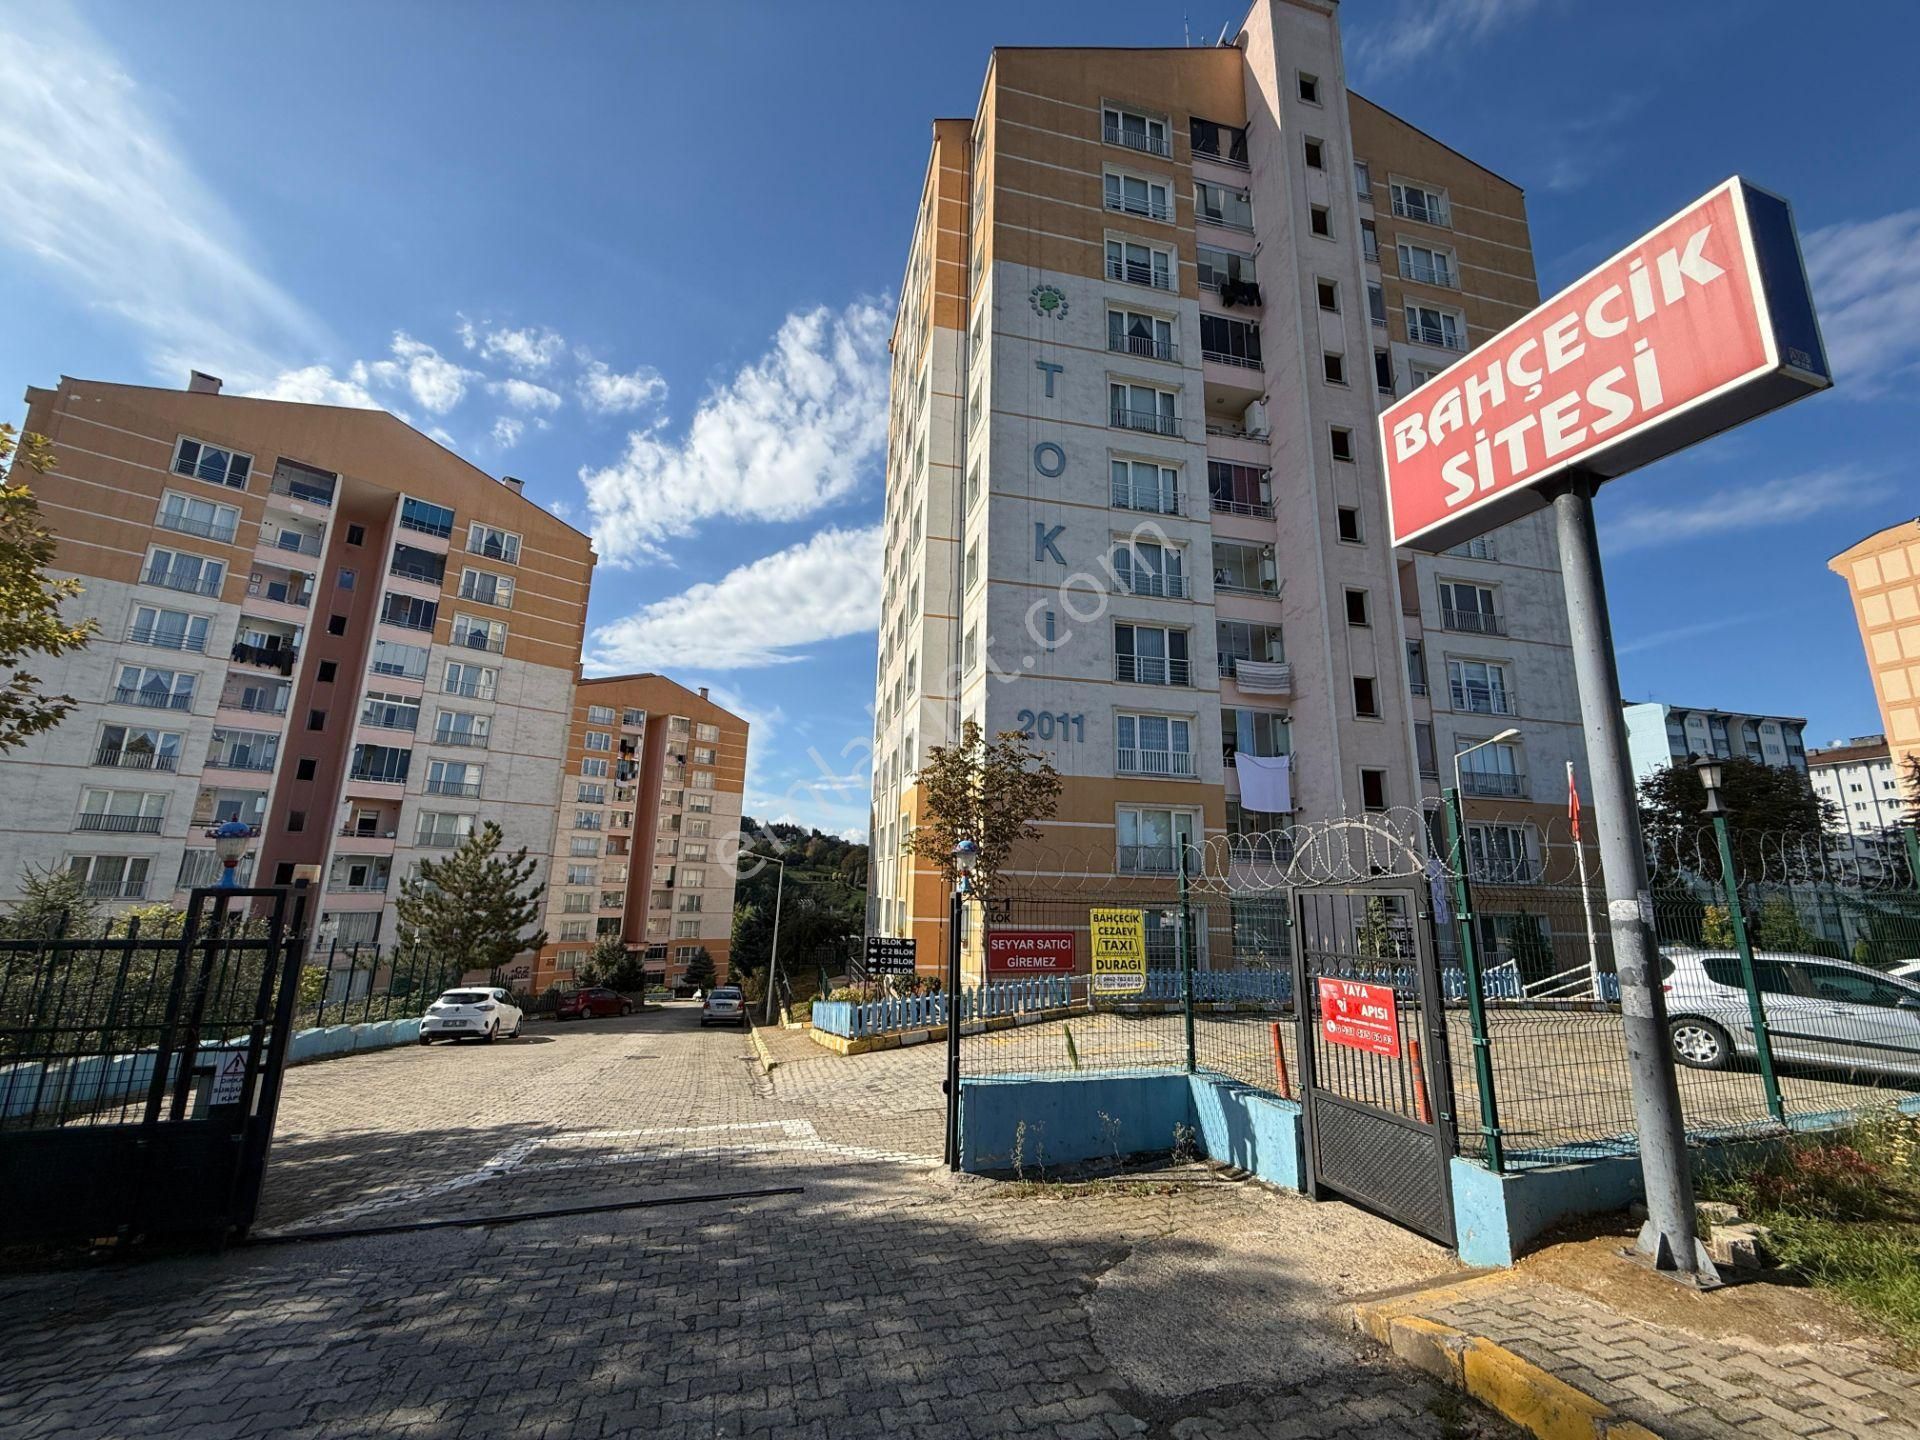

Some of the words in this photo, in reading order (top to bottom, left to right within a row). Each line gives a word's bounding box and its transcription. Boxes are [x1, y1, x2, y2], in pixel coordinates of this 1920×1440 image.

[1393, 224, 1726, 463] BAHÇECİK
[1441, 338, 1664, 507] SİTESİ
[1017, 709, 1084, 742] 2011
[1093, 913, 1140, 925] BAHÇECİK
[991, 939, 1034, 950] SEYYAR
[1036, 939, 1071, 950] SATICI
[1102, 940, 1132, 951] TAXI
[893, 958, 914, 966] BLOK
[1007, 954, 1056, 968] GİREMEZ
[1096, 957, 1141, 970] DURAĞI
[892, 967, 914, 975] BLOK
[1342, 983, 1368, 998] YAYA
